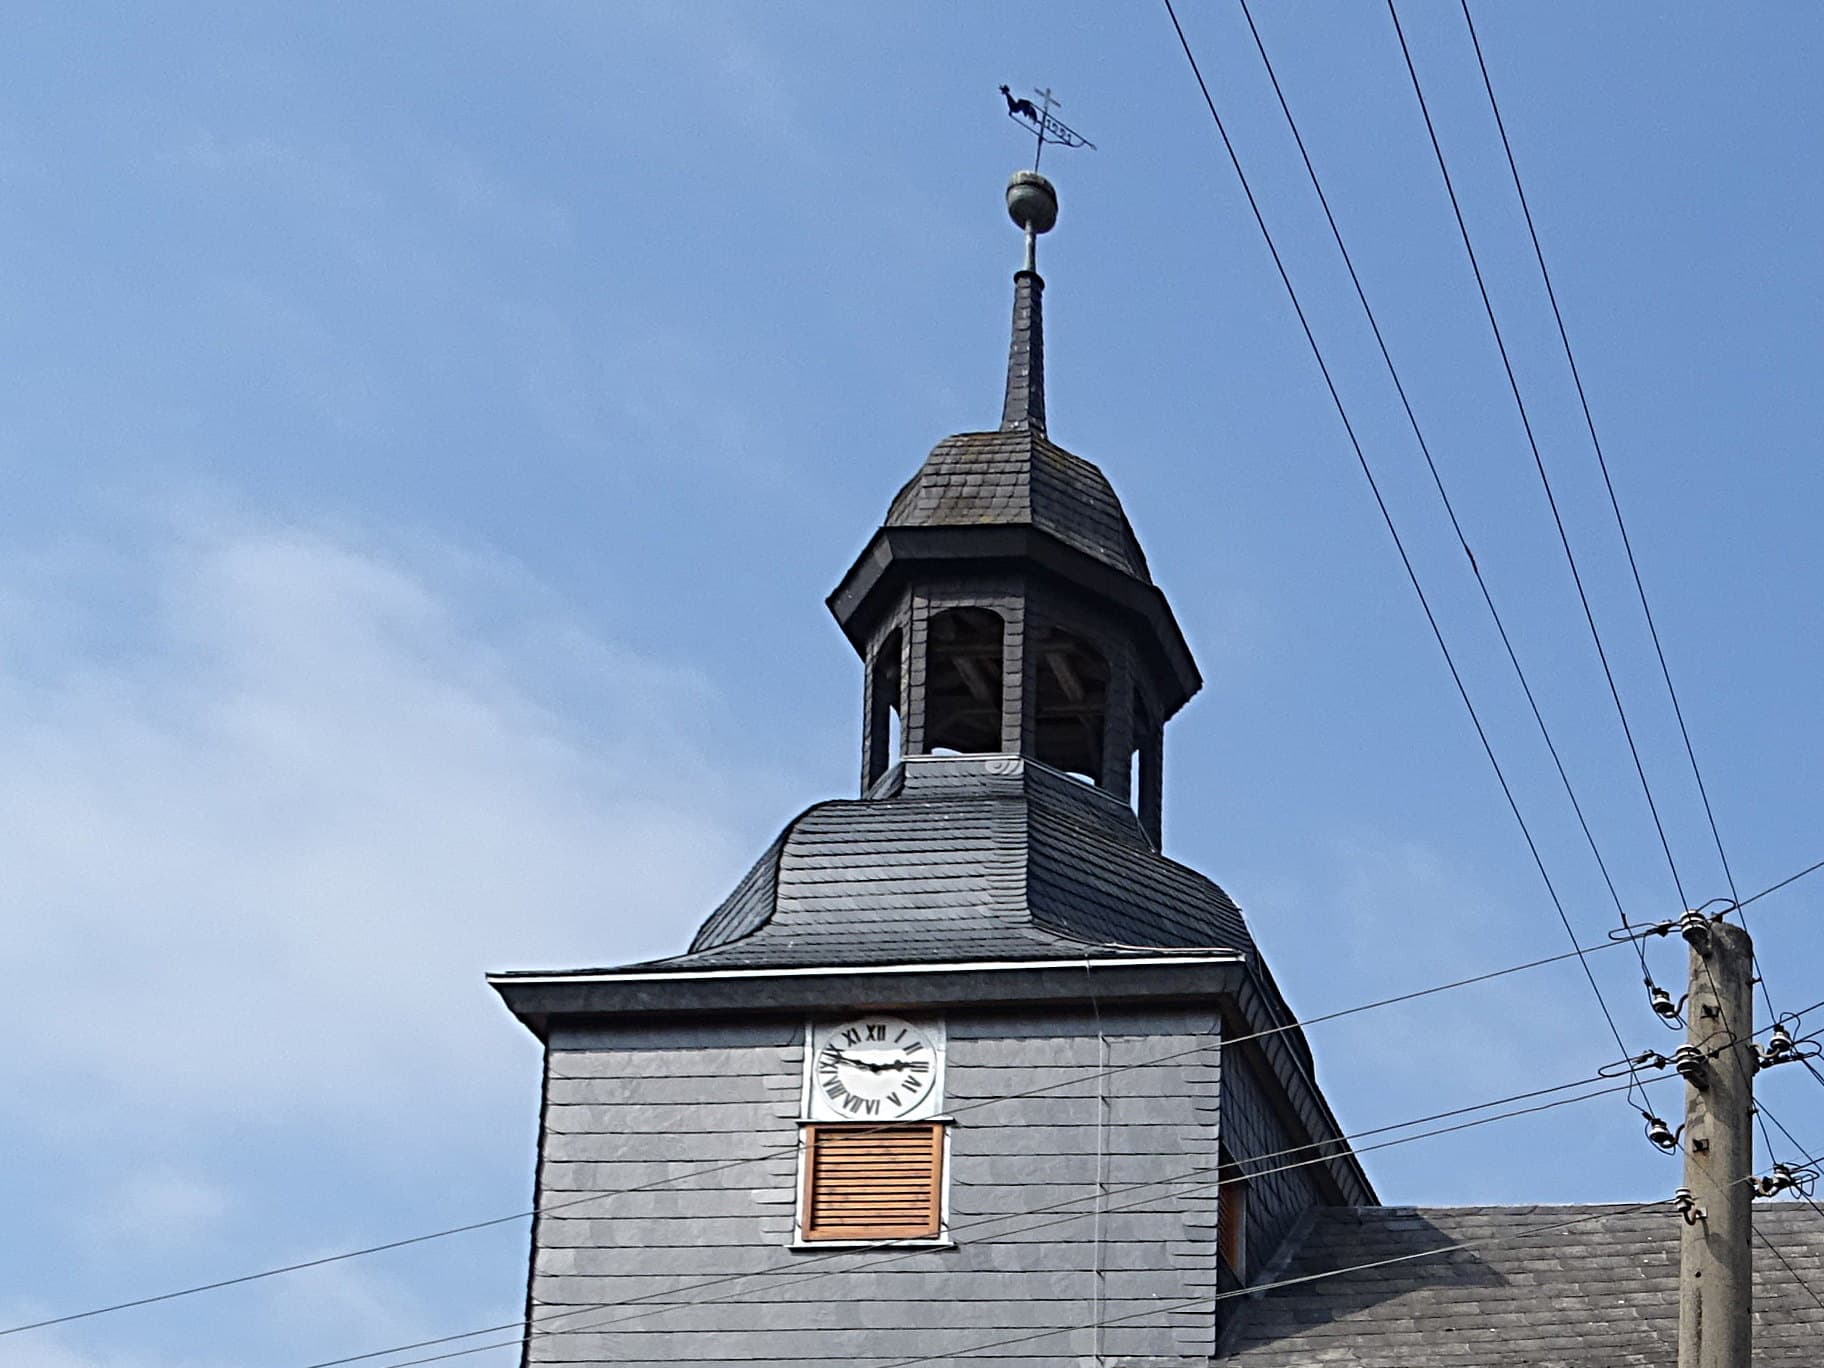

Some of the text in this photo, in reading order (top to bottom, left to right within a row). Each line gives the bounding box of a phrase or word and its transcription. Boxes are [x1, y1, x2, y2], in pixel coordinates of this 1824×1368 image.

[842, 1027, 862, 1047] XI
[866, 1024, 886, 1041] XII
[894, 1029, 908, 1043] I
[902, 1041, 924, 1055] II
[819, 1061, 839, 1074] IX
[910, 1061, 930, 1073] III
[822, 1075, 848, 1100] VIII
[901, 1074, 922, 1093] IV
[842, 1092, 864, 1114] VII
[865, 1099, 881, 1116] VI
[886, 1091, 902, 1107] V
